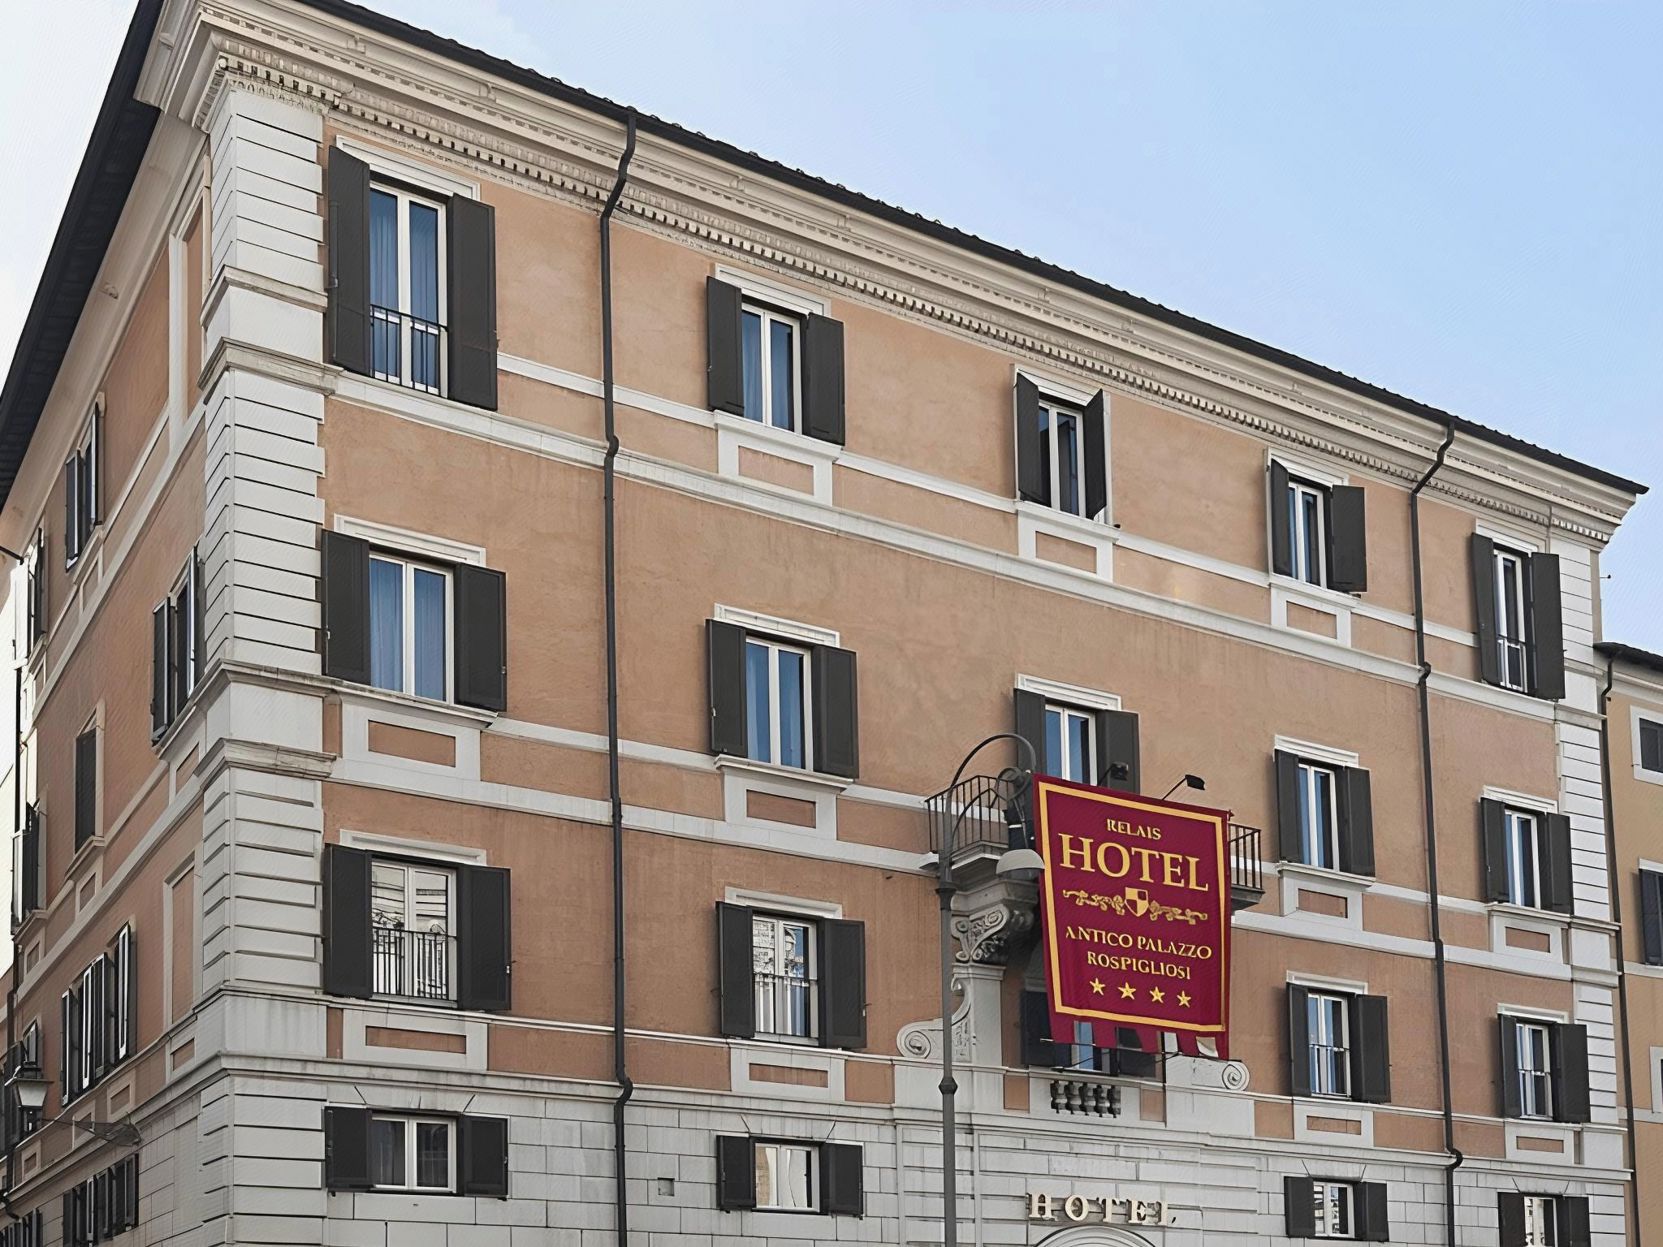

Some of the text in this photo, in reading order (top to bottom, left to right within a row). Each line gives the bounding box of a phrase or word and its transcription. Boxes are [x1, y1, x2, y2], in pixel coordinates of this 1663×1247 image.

[1106, 818, 1162, 840] RELAIS
[1058, 833, 1209, 892] HOTEL
[1065, 926, 1212, 960] ANTICO PALAZZO
[1087, 951, 1191, 980] ROSPIGLIOSI
[1027, 1193, 1177, 1227] HOTEL
